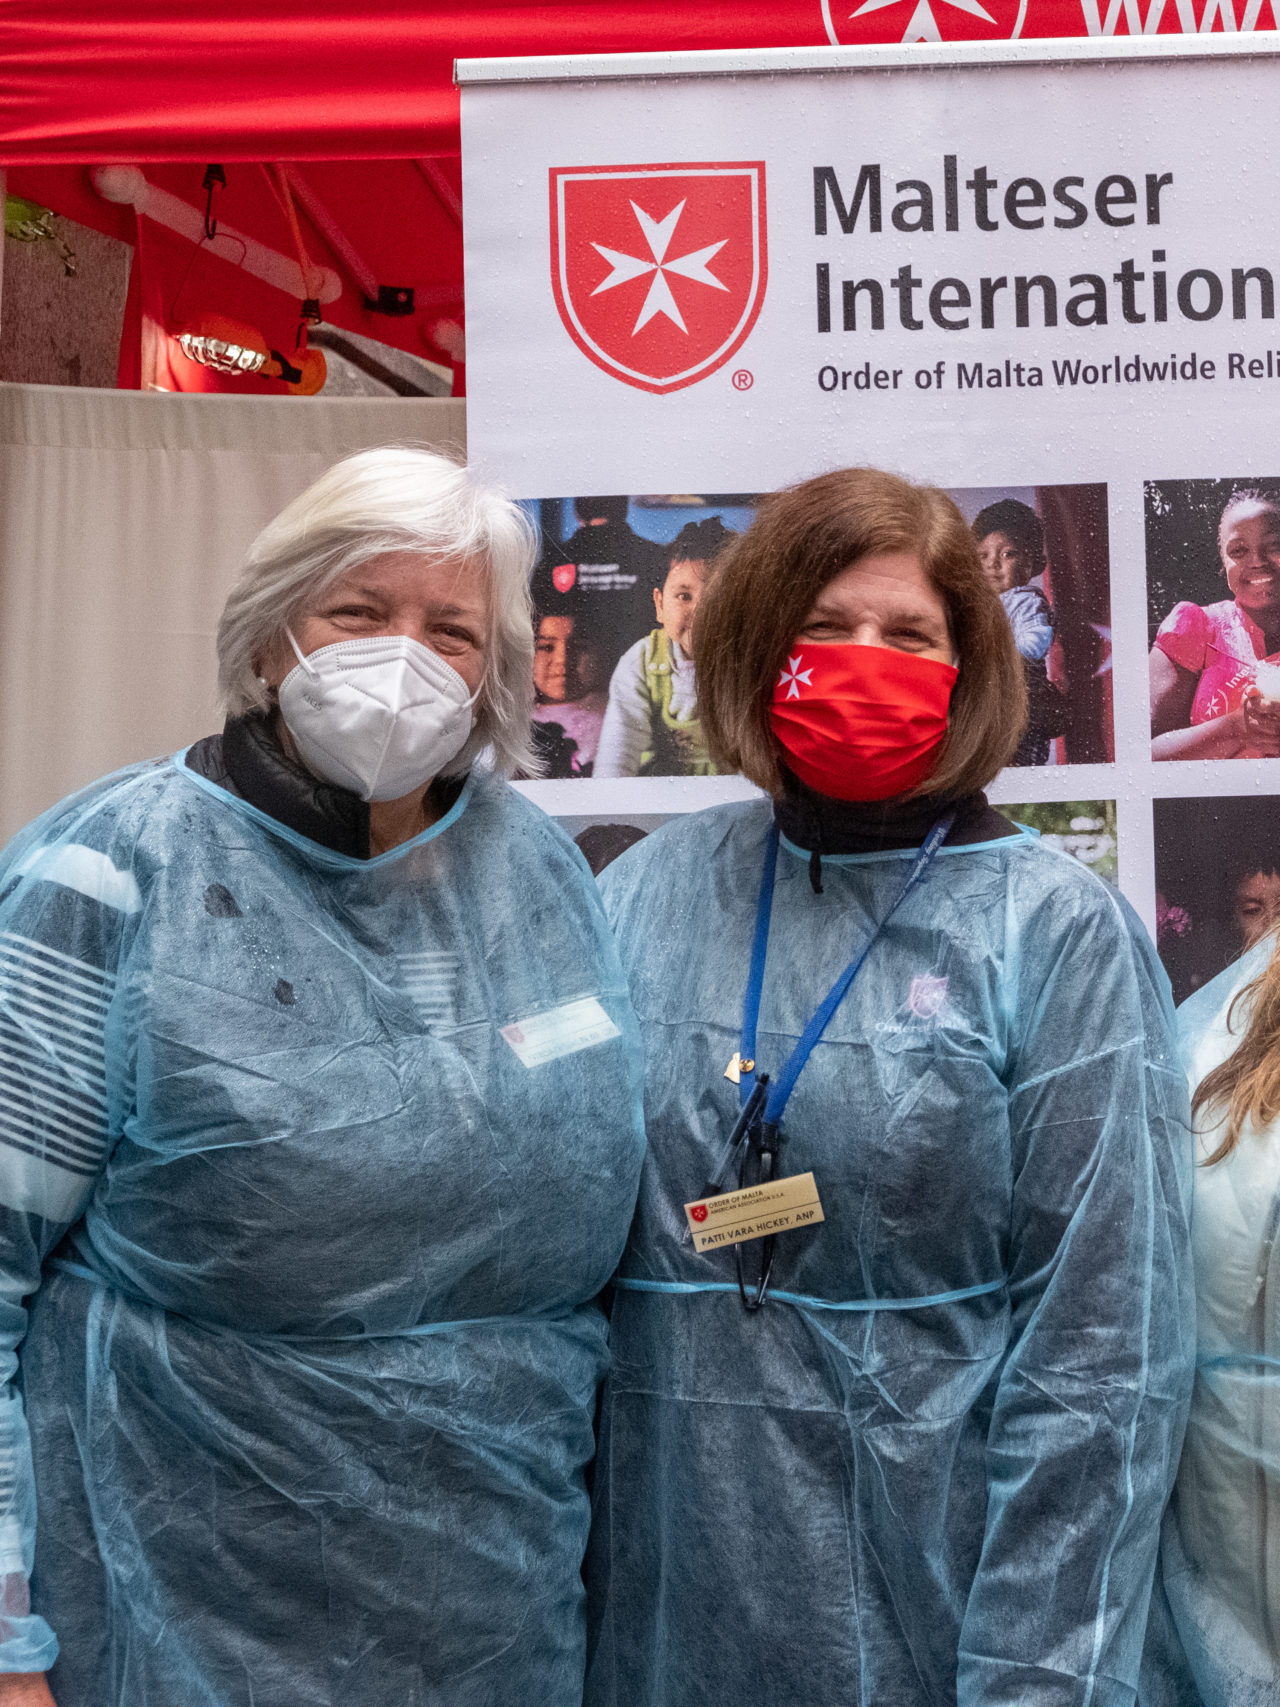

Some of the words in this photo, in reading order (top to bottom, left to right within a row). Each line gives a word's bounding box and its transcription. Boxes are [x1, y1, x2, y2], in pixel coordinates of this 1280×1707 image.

[813, 154, 1173, 236] Malteser
[818, 362, 903, 392] Order
[914, 361, 946, 390] of
[957, 359, 1043, 389] Malta
[1052, 352, 1216, 386] Worldwide
[708, 1199, 730, 1209] ORDER
[741, 1190, 763, 1200] MALTA
[701, 1233, 725, 1246] PATTI
[727, 1225, 754, 1239] VARA
[756, 1216, 793, 1231] HICKEY,
[795, 1210, 815, 1222] ANP
